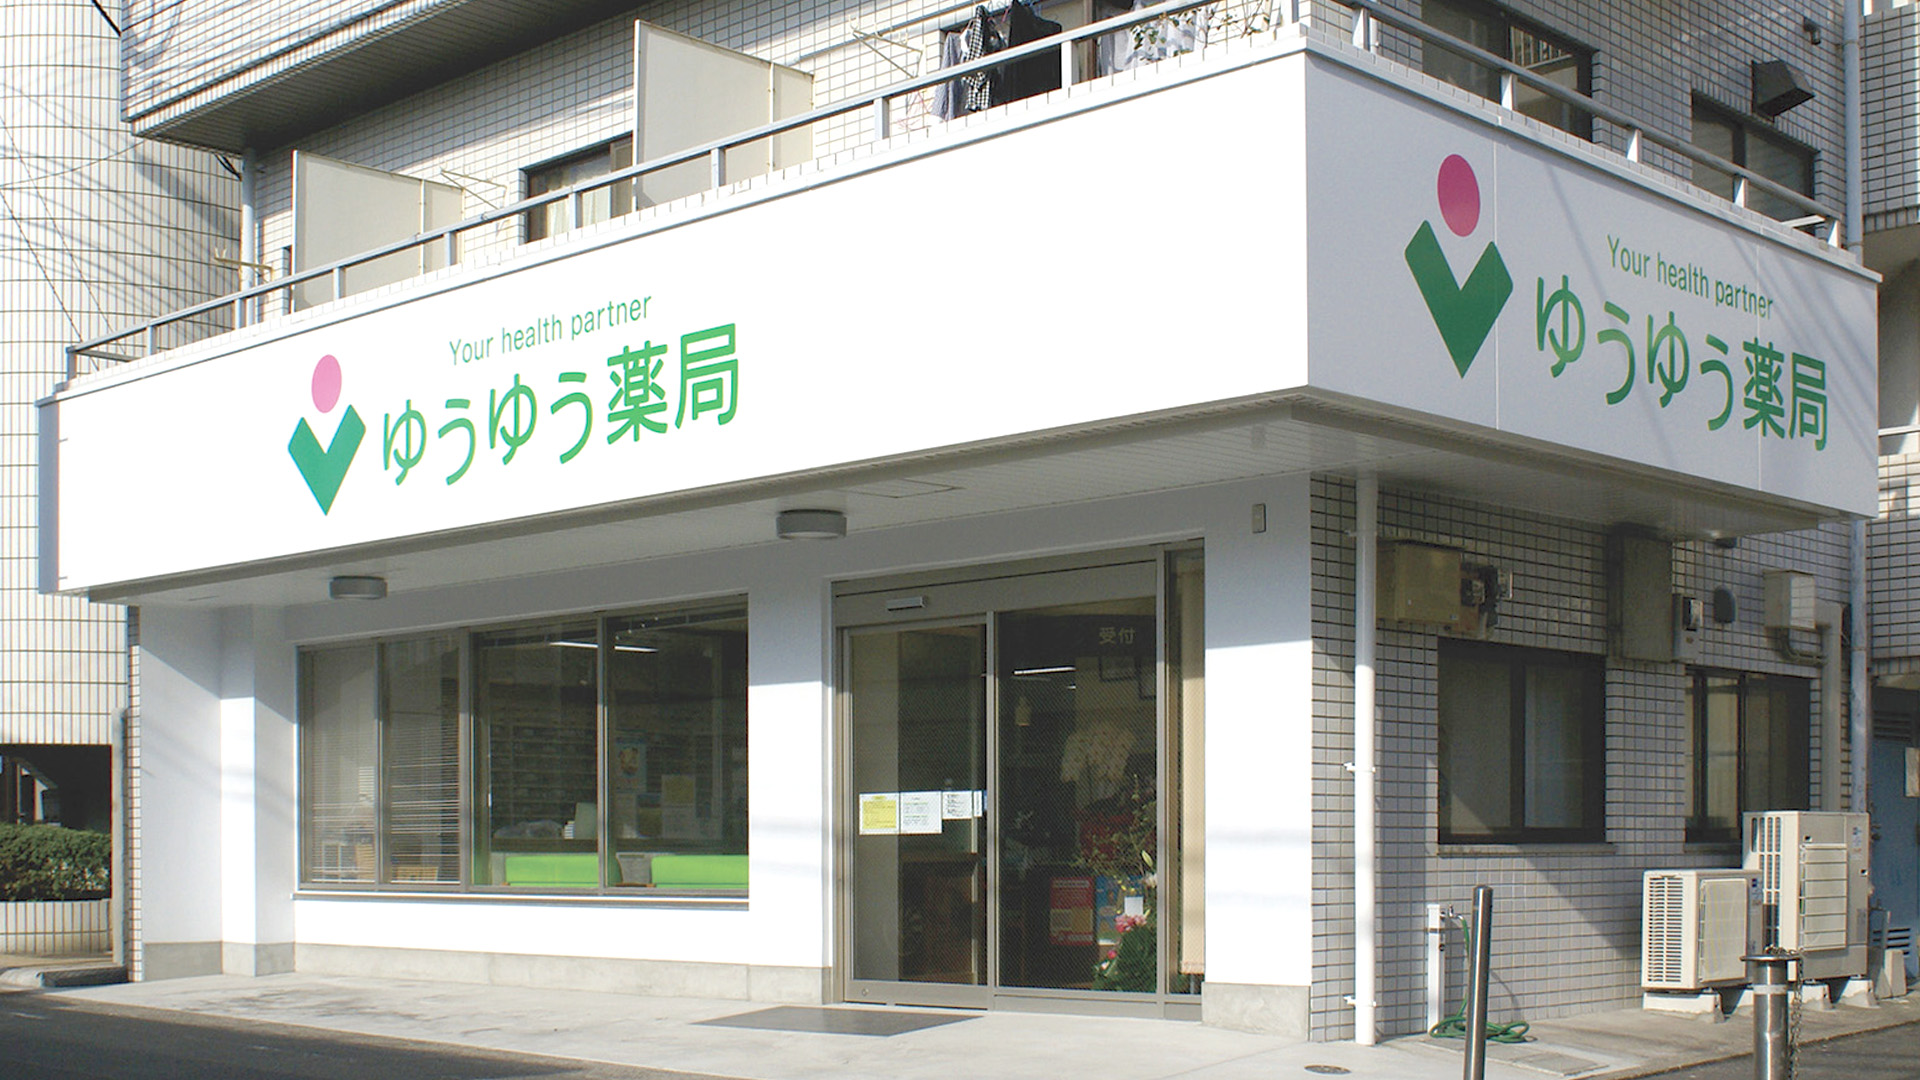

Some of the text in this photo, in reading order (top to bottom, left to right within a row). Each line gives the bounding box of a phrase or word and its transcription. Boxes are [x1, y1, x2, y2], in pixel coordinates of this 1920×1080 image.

[1607, 234, 1774, 319] Your health partner
[448, 296, 652, 366] Your health partner
[1536, 274, 1829, 452] ゆうゆう薬局
[383, 322, 740, 486] ゆうゆう薬局
[1099, 626, 1136, 645] 受付
